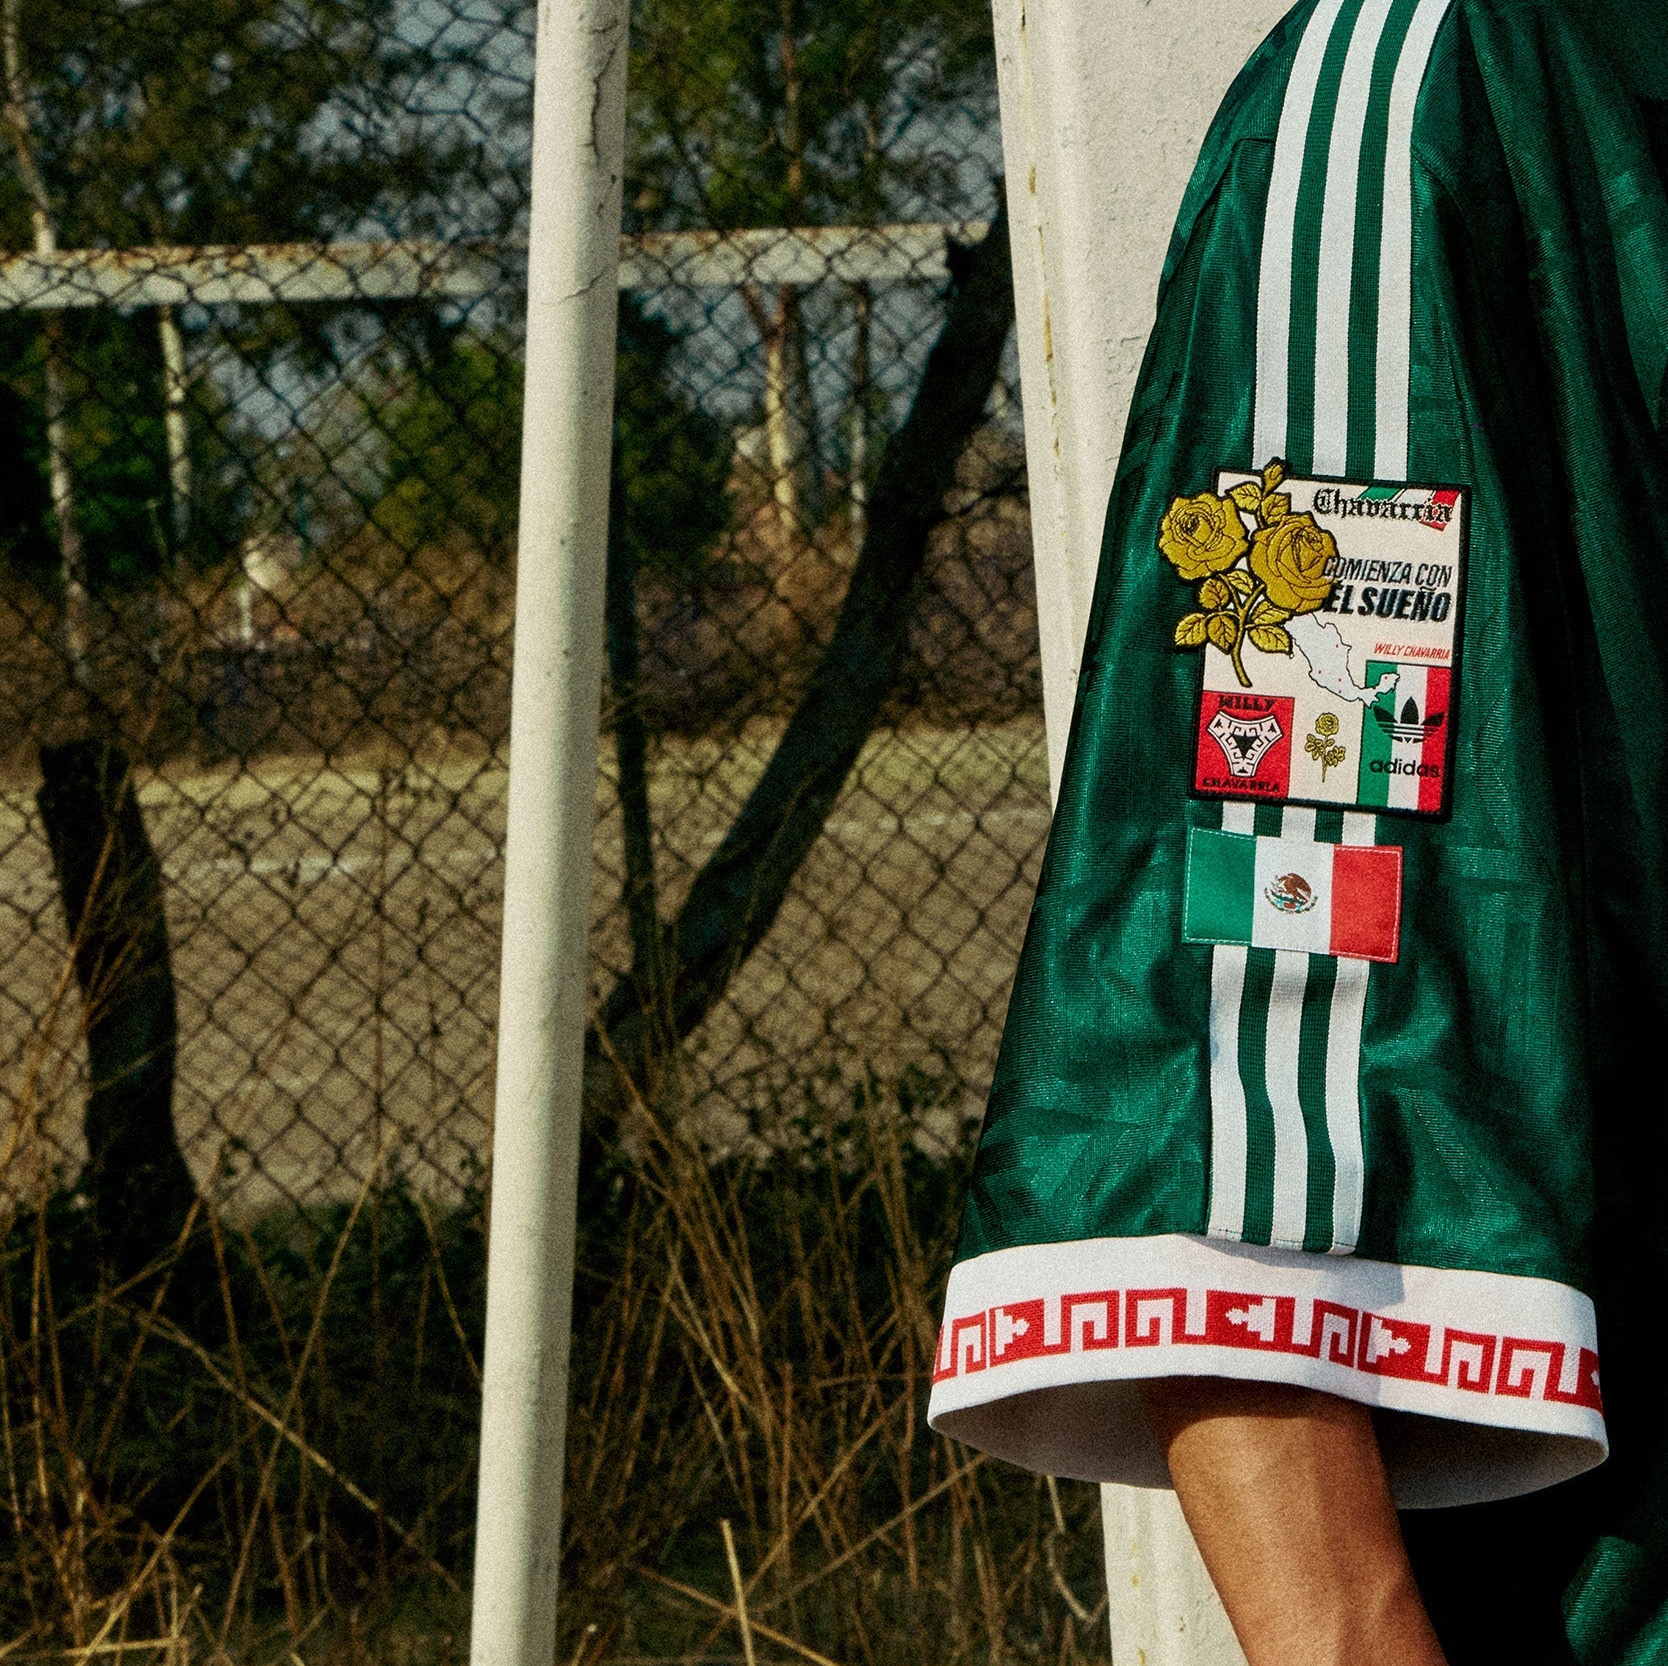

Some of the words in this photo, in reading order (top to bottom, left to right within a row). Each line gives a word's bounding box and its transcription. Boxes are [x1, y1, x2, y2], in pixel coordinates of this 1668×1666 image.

[1313, 487, 1453, 523] Chavarria
[1322, 556, 1412, 586] COMIENZA
[1416, 563, 1453, 588] CON
[1323, 582, 1355, 615] EL
[1358, 586, 1453, 623] SUEÑO
[1374, 642, 1405, 657] WILLY
[1403, 645, 1451, 661] CHAVARRIA
[1217, 693, 1278, 711] WILLY
[1368, 757, 1441, 779] adidas
[1201, 777, 1281, 794] CHAVARRIA
